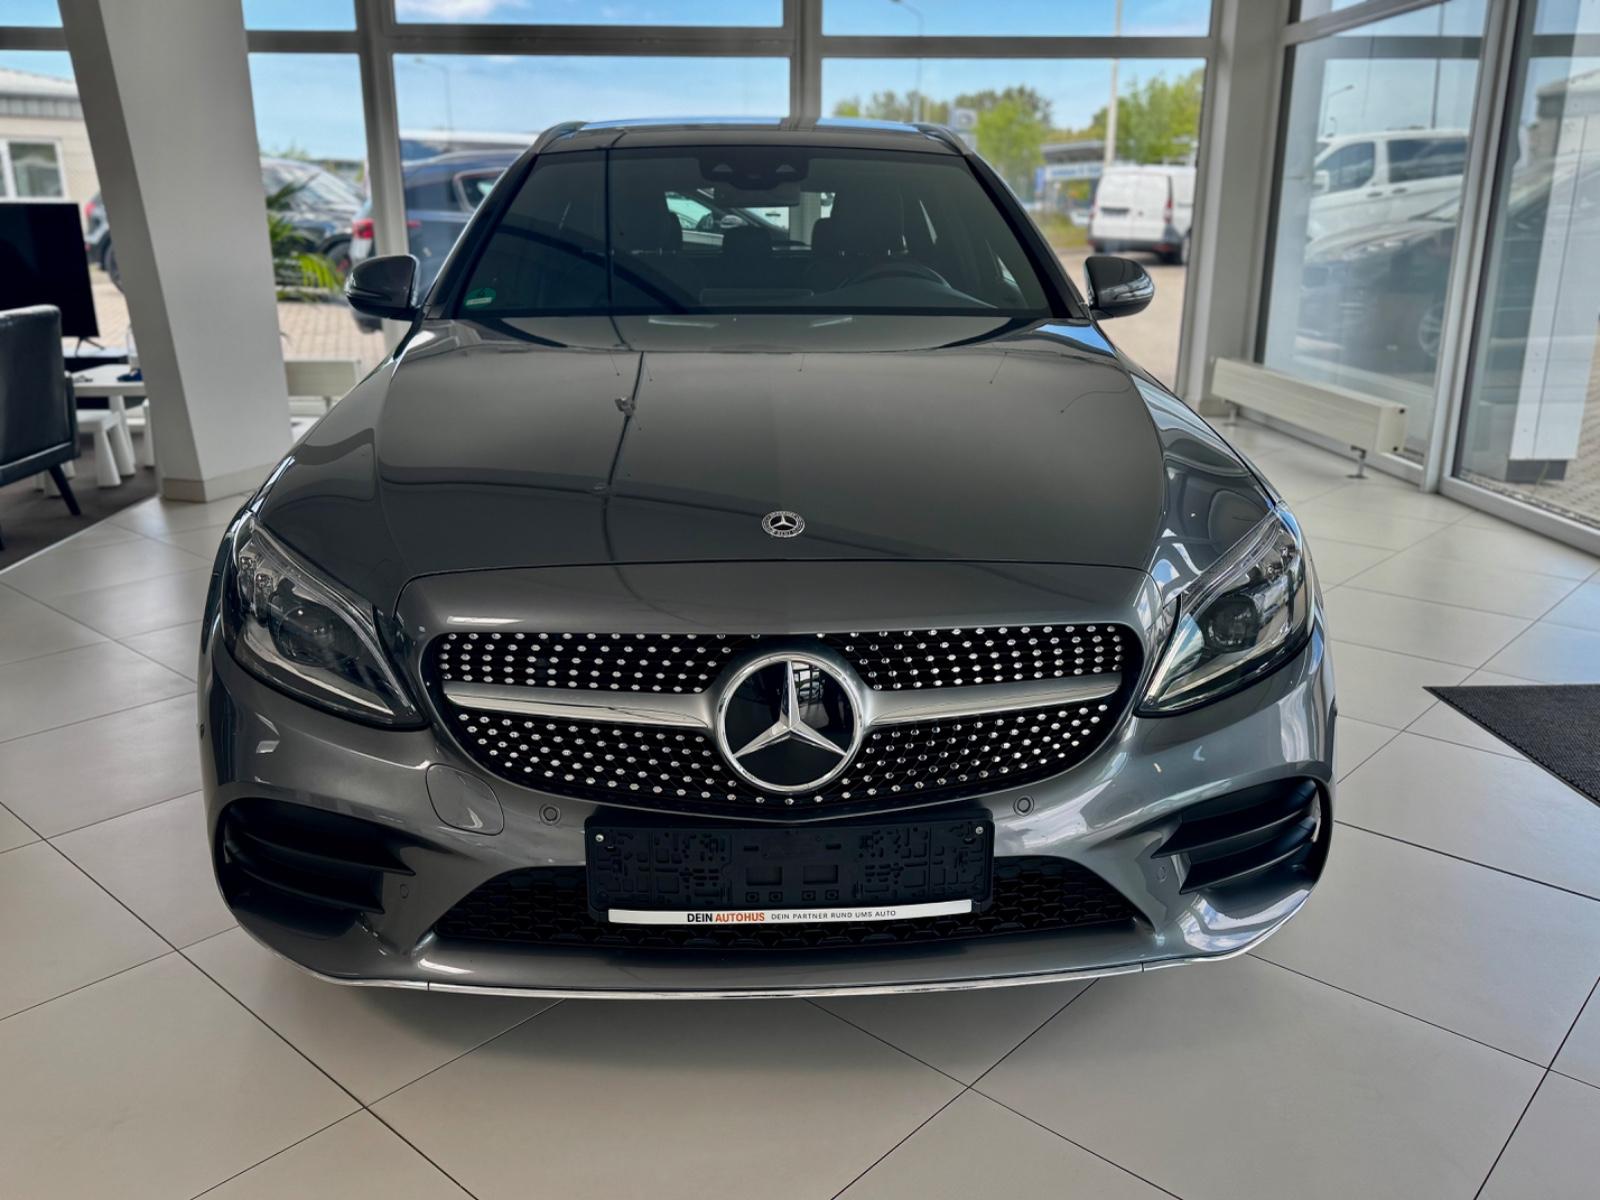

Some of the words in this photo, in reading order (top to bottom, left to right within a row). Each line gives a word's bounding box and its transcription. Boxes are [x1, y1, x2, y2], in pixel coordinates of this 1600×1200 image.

[687, 913, 713, 922] DEIN
[715, 912, 765, 922] AUTOHUS
[792, 912, 828, 920] PARTNER
[874, 910, 896, 918] AUTO
